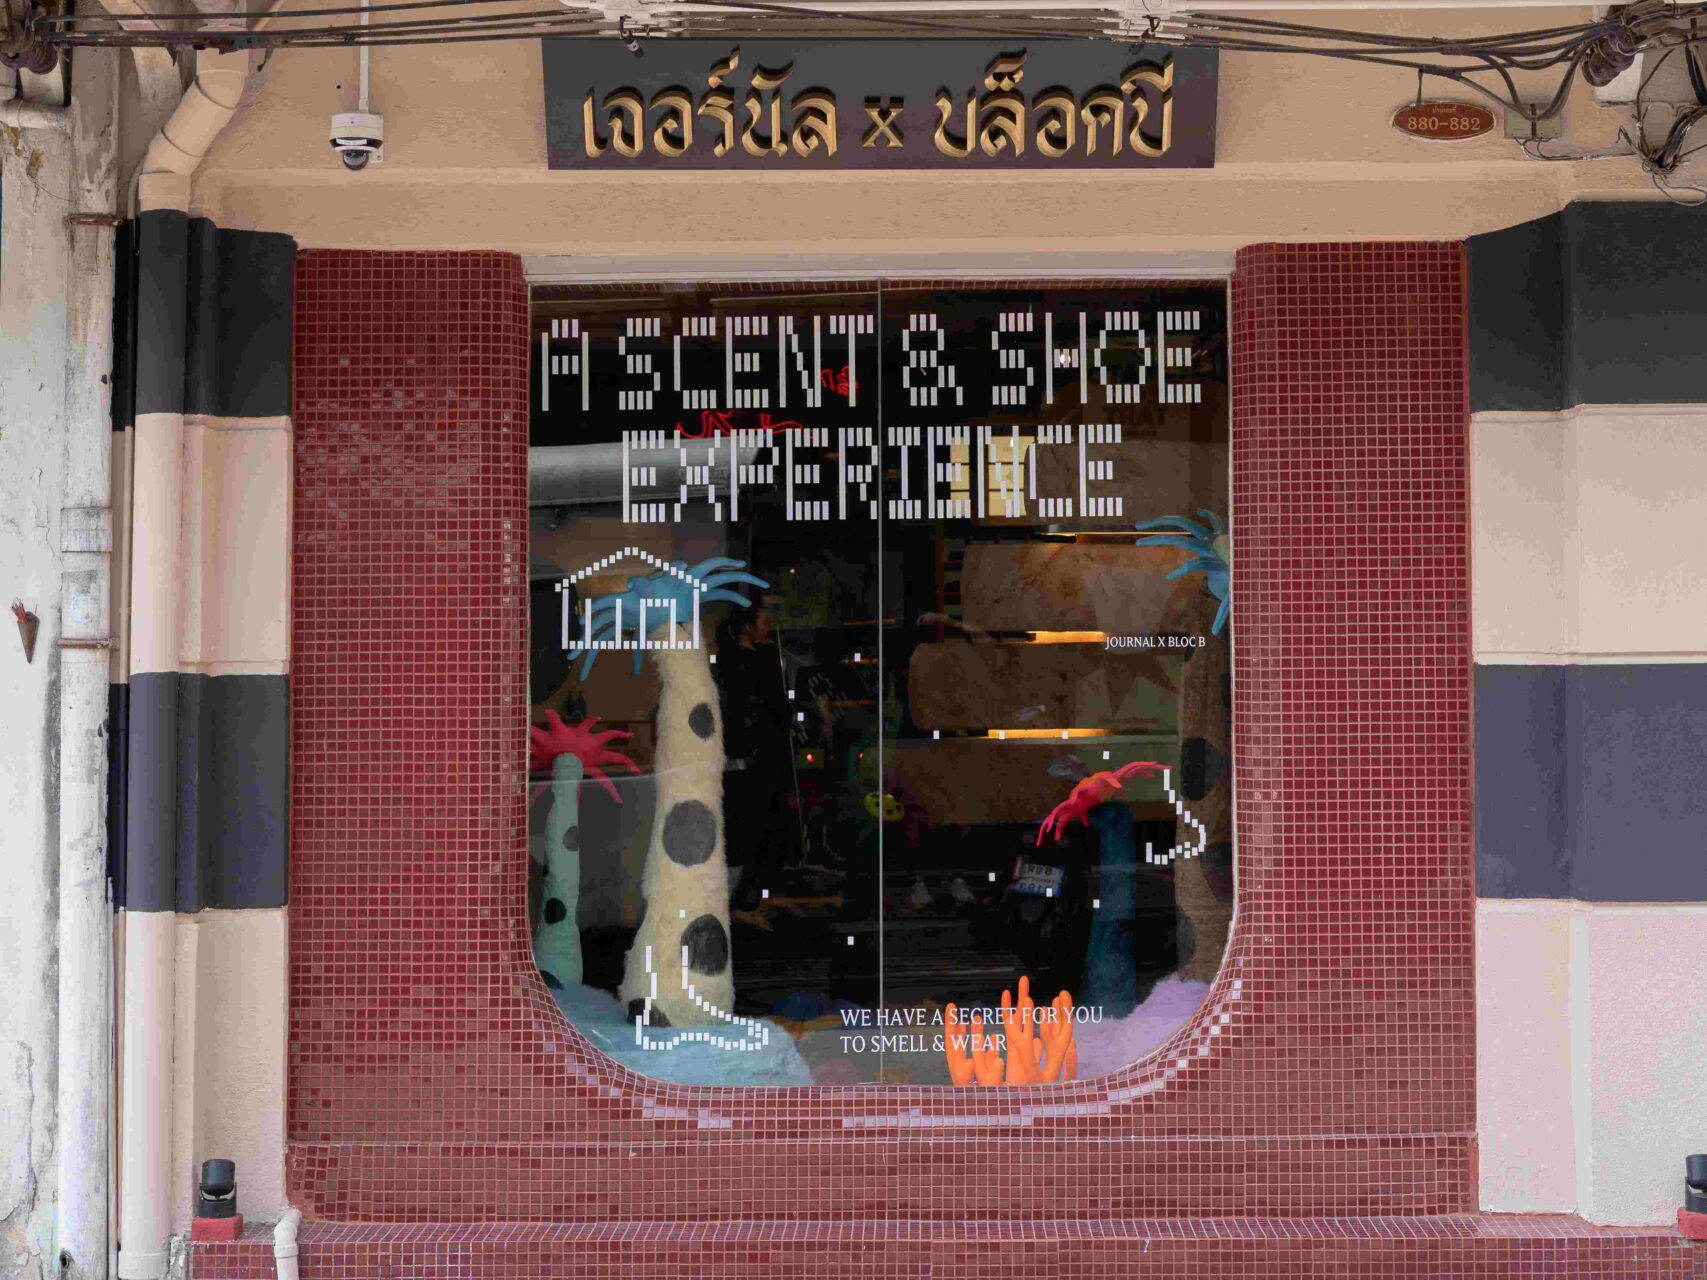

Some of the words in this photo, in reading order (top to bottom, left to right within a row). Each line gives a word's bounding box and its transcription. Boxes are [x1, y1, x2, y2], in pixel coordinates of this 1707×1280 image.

[583, 45, 838, 158] เจอร์นัล
[1407, 117, 1480, 131] 880-882
[542, 319, 589, 411] A
[619, 315, 874, 410] SCENT
[902, 314, 963, 406] &
[992, 311, 1201, 405] SHOE
[622, 425, 1123, 523] EXPERIENCE
[1105, 636, 1155, 650] JOURNAL
[1158, 636, 1166, 648] X
[1168, 636, 1196, 648] BLOC
[1198, 636, 1206, 647] B
[840, 1008, 871, 1027] WE
[877, 1008, 926, 1026] HAVE
[931, 1008, 944, 1026] A
[949, 1007, 1017, 1025] SECRET
[1022, 1006, 1058, 1024] FOR
[1064, 1006, 1103, 1024] YOU
[840, 1035, 866, 1053] TO
[871, 1035, 928, 1053] SMELL
[932, 1034, 945, 1052] &
[950, 1033, 1007, 1052] WEAR
